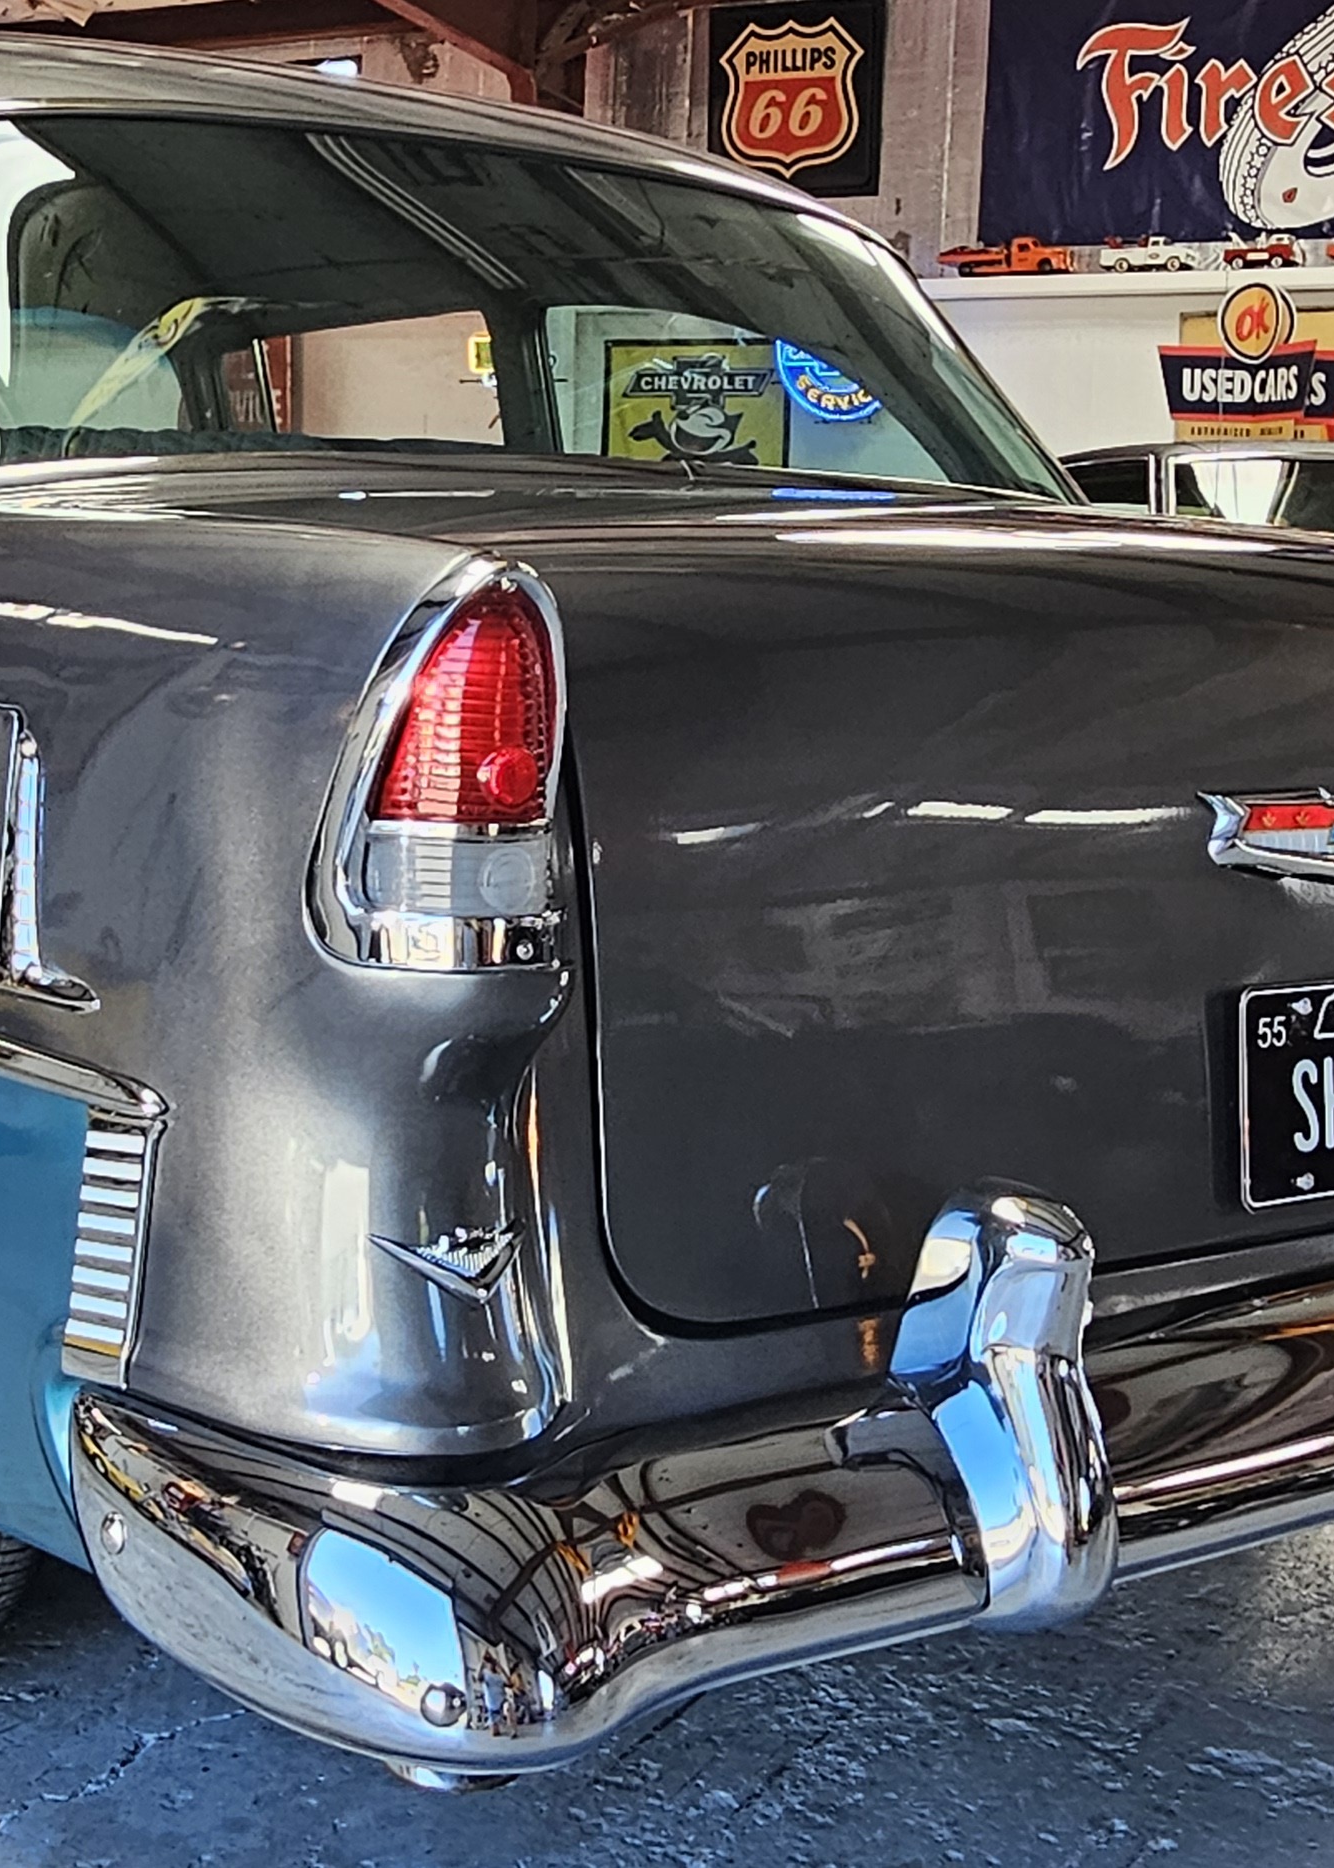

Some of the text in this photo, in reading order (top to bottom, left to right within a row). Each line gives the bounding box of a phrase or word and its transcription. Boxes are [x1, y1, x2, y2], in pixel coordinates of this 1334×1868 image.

[745, 46, 837, 76] PHILLIPS
[749, 86, 828, 139] 66
[1235, 296, 1271, 342] OK
[640, 375, 757, 391] CHEVROLET
[1182, 365, 1299, 403] USED CARS
[1257, 1016, 1288, 1049] 55
